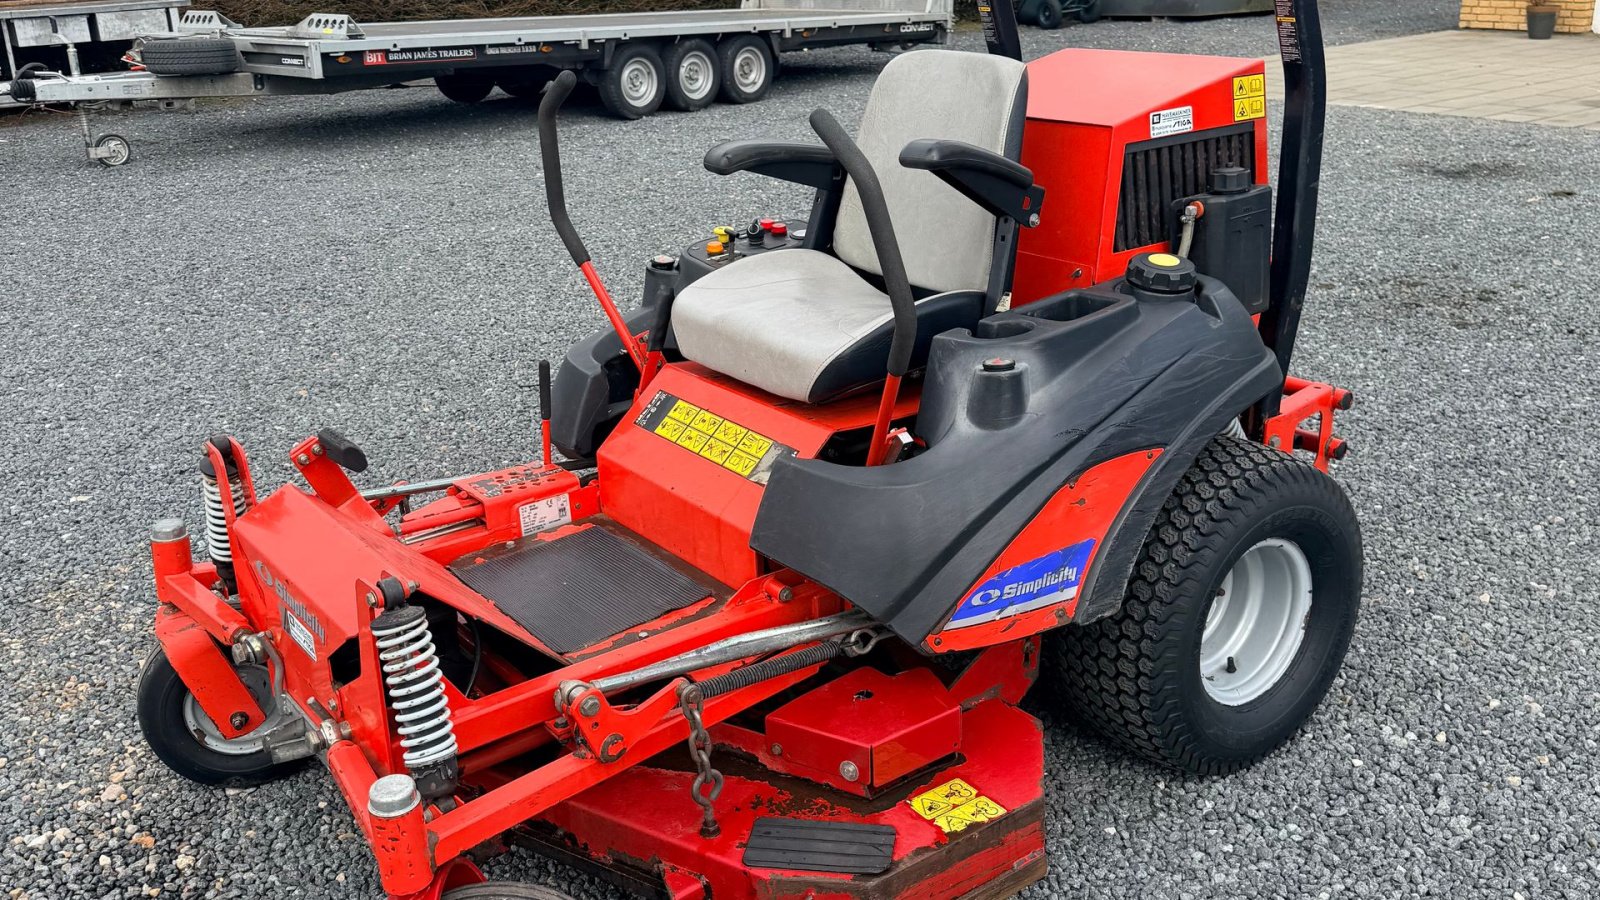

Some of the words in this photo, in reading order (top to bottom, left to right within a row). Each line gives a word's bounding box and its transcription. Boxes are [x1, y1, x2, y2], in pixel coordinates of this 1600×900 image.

[900, 24, 935, 32] CONNECT
[366, 52, 383, 62] BJT
[388, 52, 412, 61] BRIAN
[414, 50, 437, 60] JAMES
[439, 48, 474, 58] TRAILERS
[1003, 567, 1076, 599] Simplicity
[275, 579, 325, 645] Simplicity
